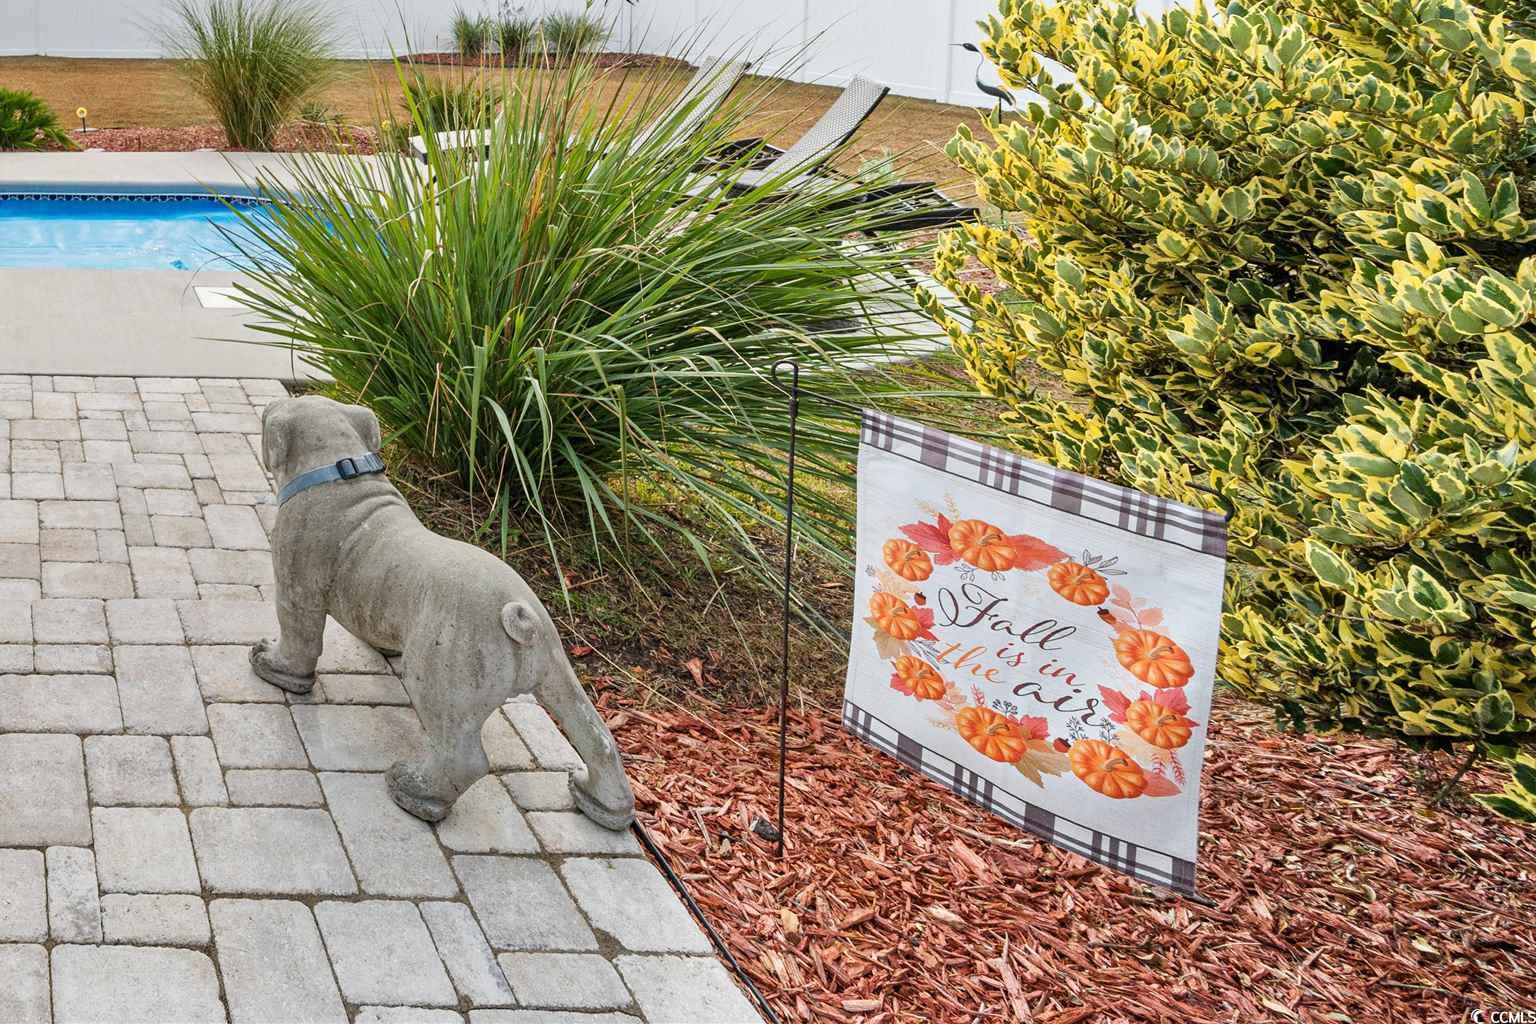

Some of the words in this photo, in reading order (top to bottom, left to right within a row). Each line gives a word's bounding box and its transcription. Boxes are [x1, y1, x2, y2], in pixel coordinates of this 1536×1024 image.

[938, 583, 1077, 651] Fall
[936, 642, 1007, 684] the
[1013, 682, 1110, 727] air
[996, 642, 1025, 667] is
[1038, 658, 1085, 686] in
